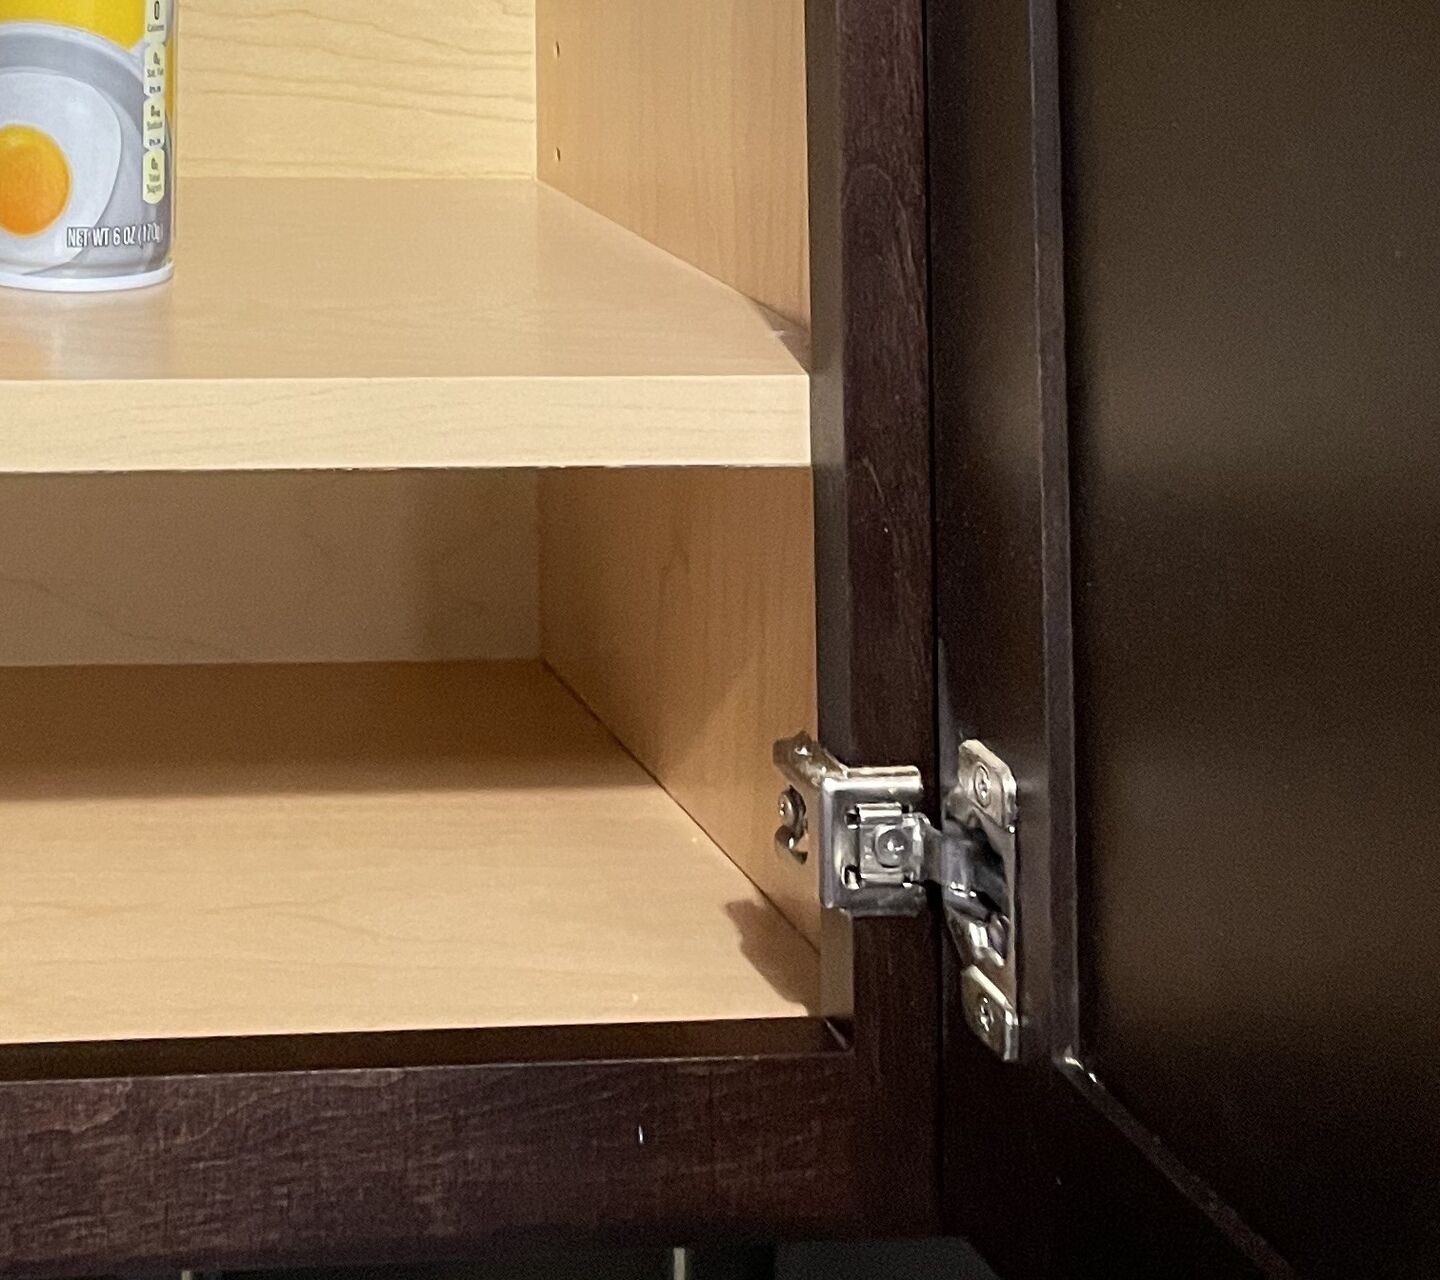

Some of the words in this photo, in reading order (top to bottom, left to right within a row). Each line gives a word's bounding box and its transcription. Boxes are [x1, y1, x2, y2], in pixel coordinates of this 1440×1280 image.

[67, 226, 88, 248] NET
[92, 226, 110, 247] WT
[123, 225, 136, 245] OZ
